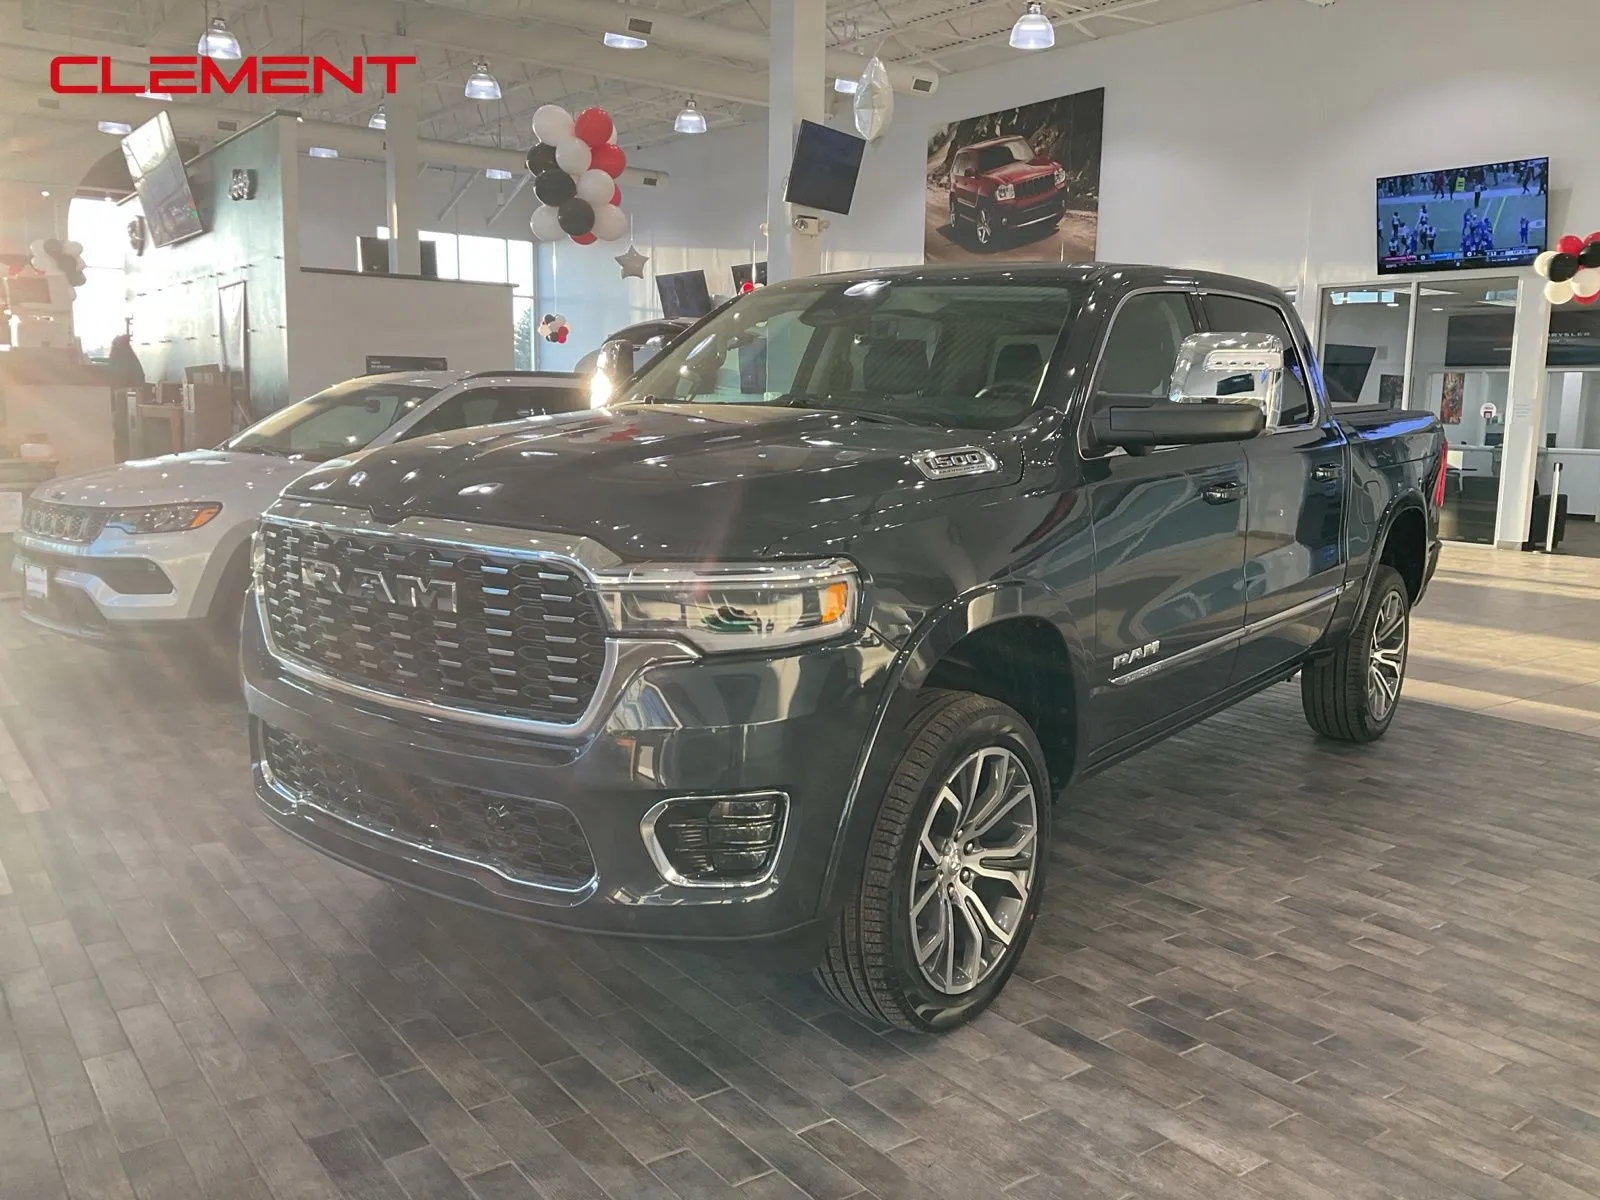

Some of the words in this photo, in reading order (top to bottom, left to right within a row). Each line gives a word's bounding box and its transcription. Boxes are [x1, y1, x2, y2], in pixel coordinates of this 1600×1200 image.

[925, 453, 982, 469] 1500
[301, 557, 457, 613] RAM
[1112, 640, 1160, 670] RAM
